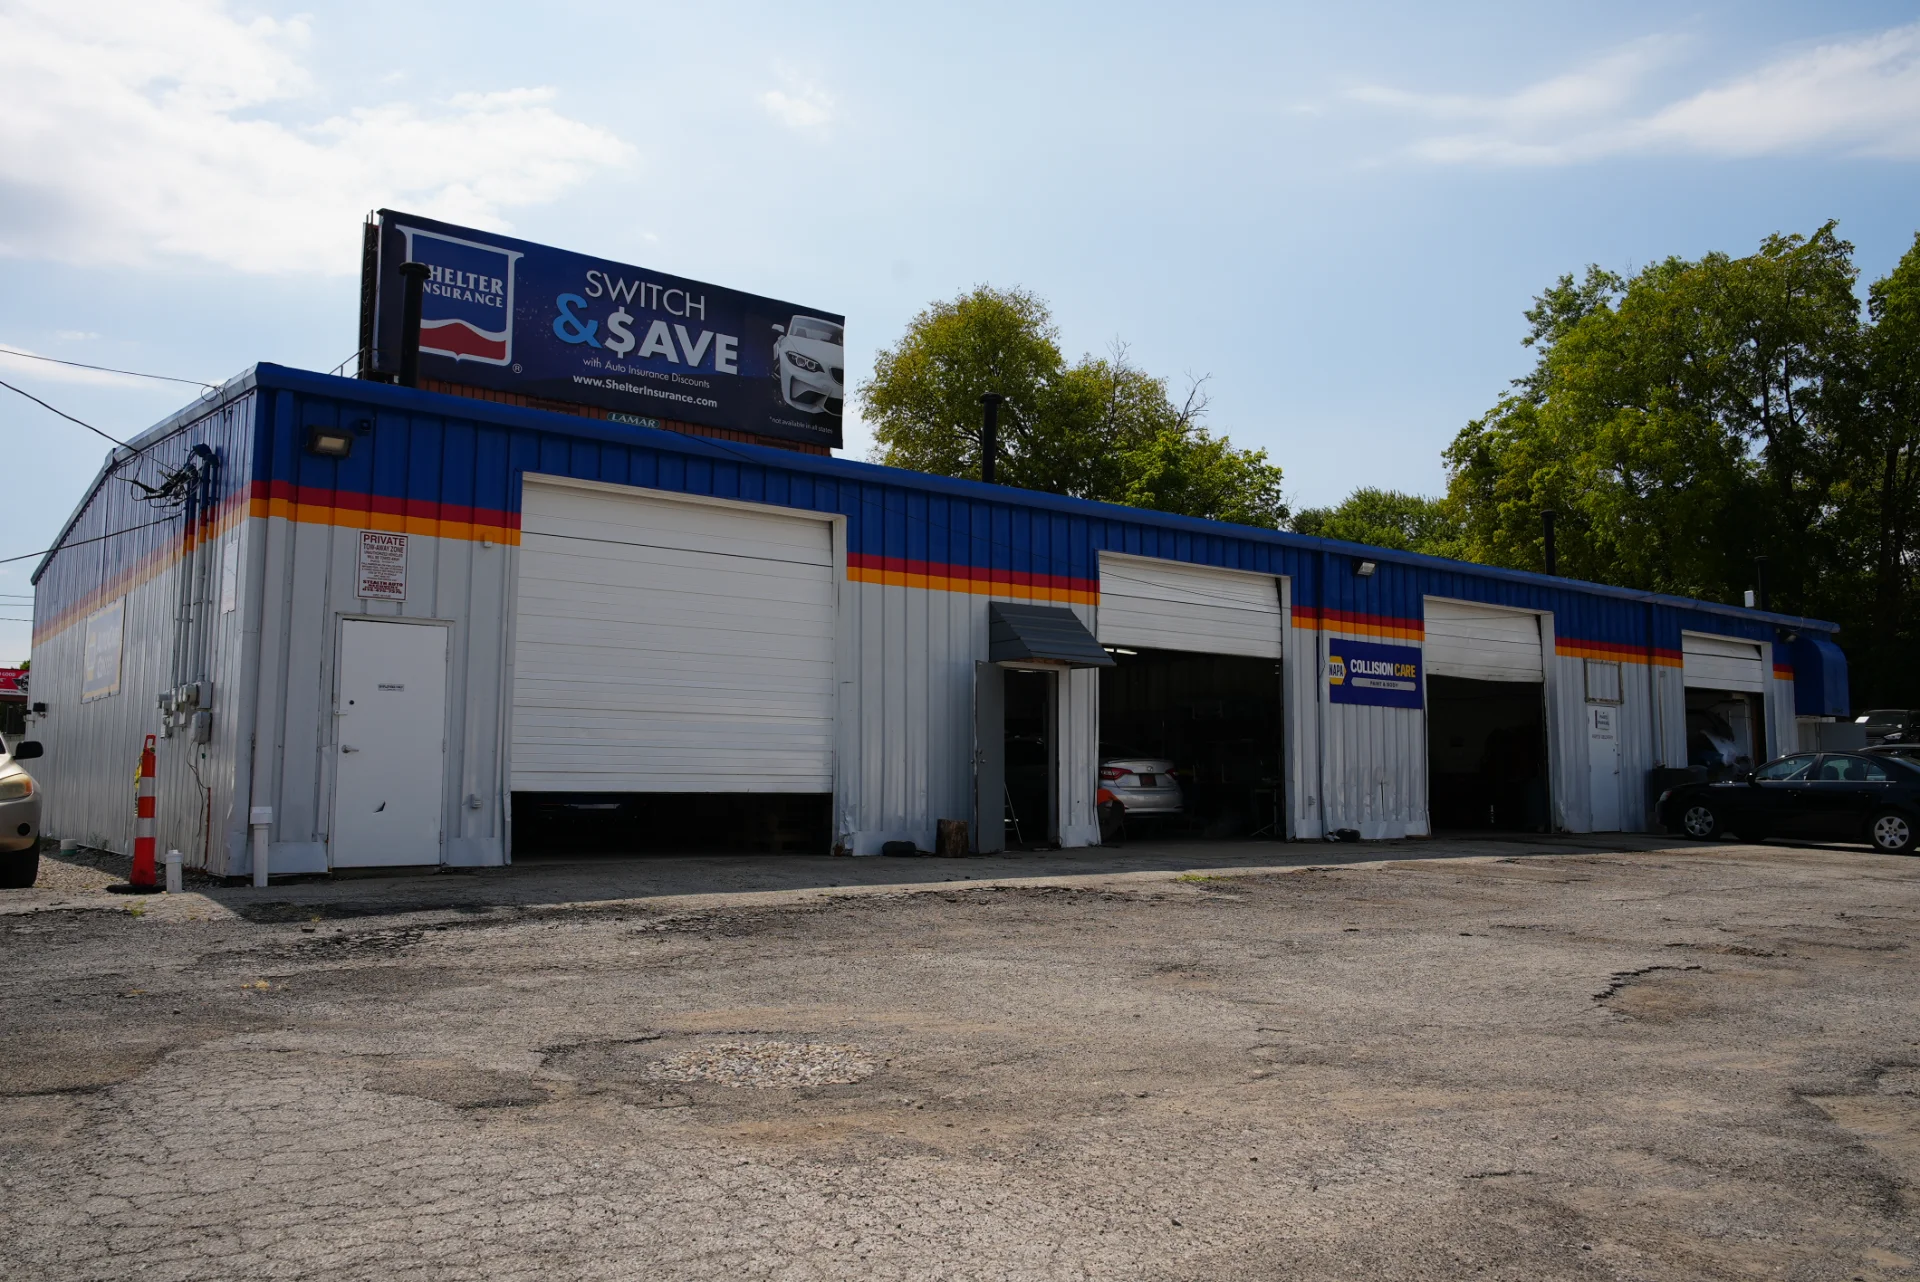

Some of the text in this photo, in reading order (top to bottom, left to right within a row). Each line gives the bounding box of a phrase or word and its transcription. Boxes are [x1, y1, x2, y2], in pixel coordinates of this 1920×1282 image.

[427, 264, 504, 295] HELTER
[422, 282, 503, 308] NSURANCE
[585, 270, 705, 321] SWITCH
[604, 306, 738, 375] $AVE
[583, 357, 710, 389] with Auto Insurance Discounts
[572, 374, 718, 408] www.ShelterInsurance.com
[611, 412, 656, 428] LAMAR
[782, 420, 805, 429] available
[364, 534, 405, 546] PRIVATE
[364, 543, 389, 551] TOW-AWAY
[1329, 664, 1343, 676] NAPA
[1350, 659, 1416, 677] COLLISION CARE
